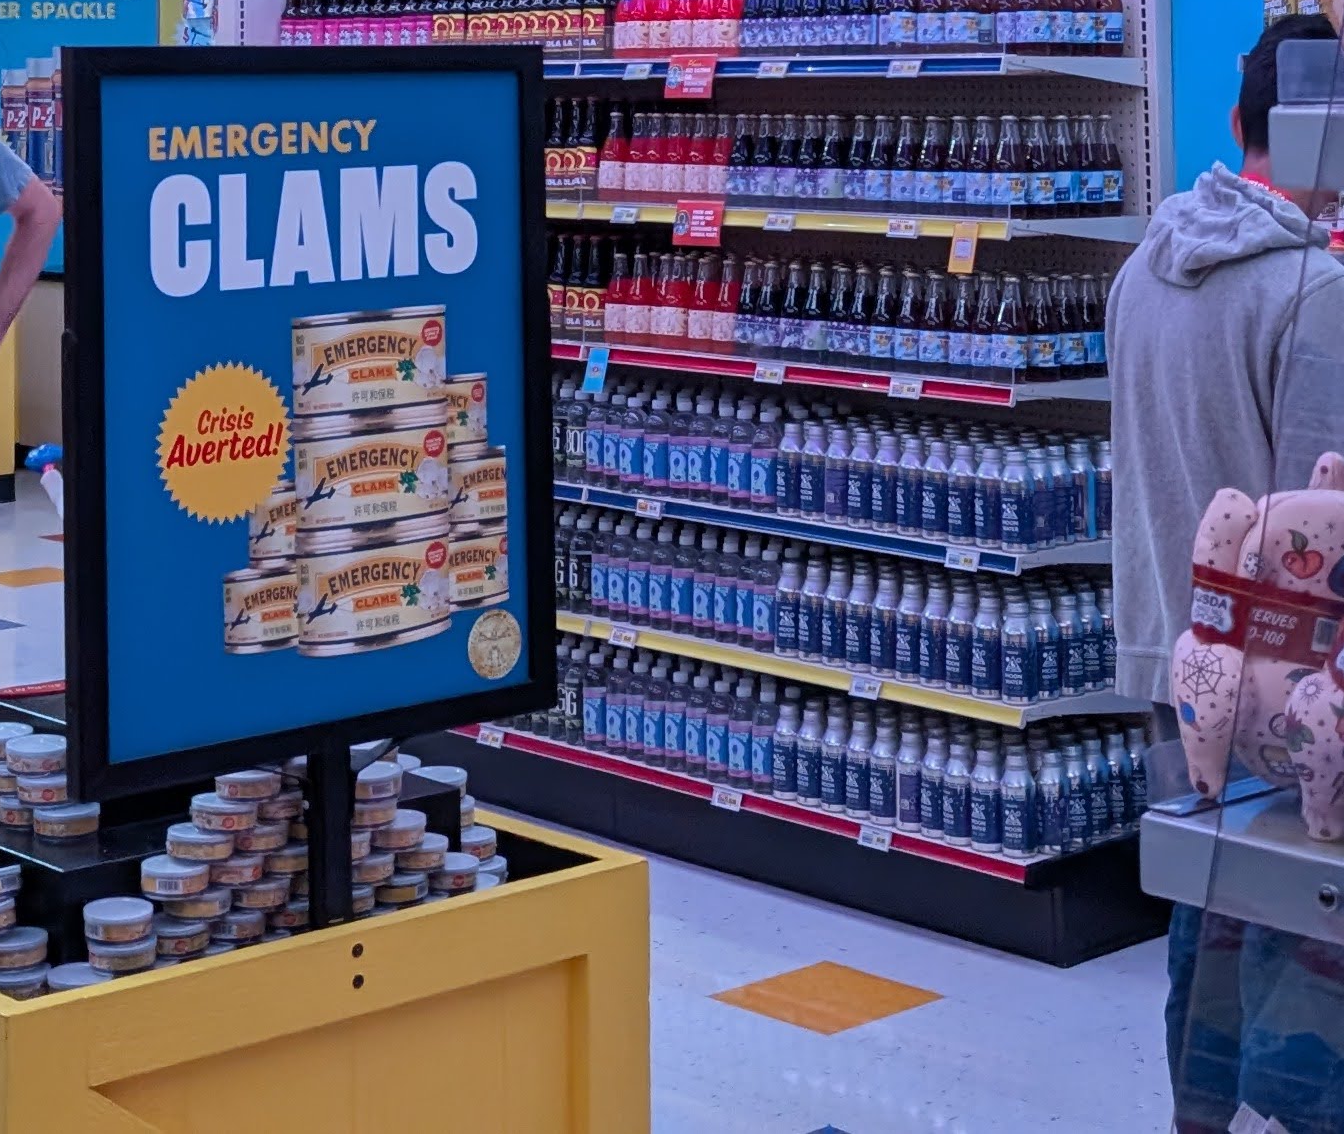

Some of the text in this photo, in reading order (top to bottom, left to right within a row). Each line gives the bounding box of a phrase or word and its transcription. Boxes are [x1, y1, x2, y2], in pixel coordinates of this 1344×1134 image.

[31, 1, 117, 20] SPACKLE
[148, 119, 377, 161] EMERGENCY
[149, 161, 479, 297] CLAMS
[323, 335, 417, 366] EMERGENCY
[351, 367, 393, 380] CLAMS
[197, 405, 254, 435] Crisis
[166, 423, 284, 469] Averted!
[326, 447, 419, 480] EMERGENCY
[463, 466, 506, 488] EMERGEN
[352, 482, 396, 495] CLAMS
[328, 562, 422, 595] EMERGENCY
[356, 594, 398, 608] CLAMS
